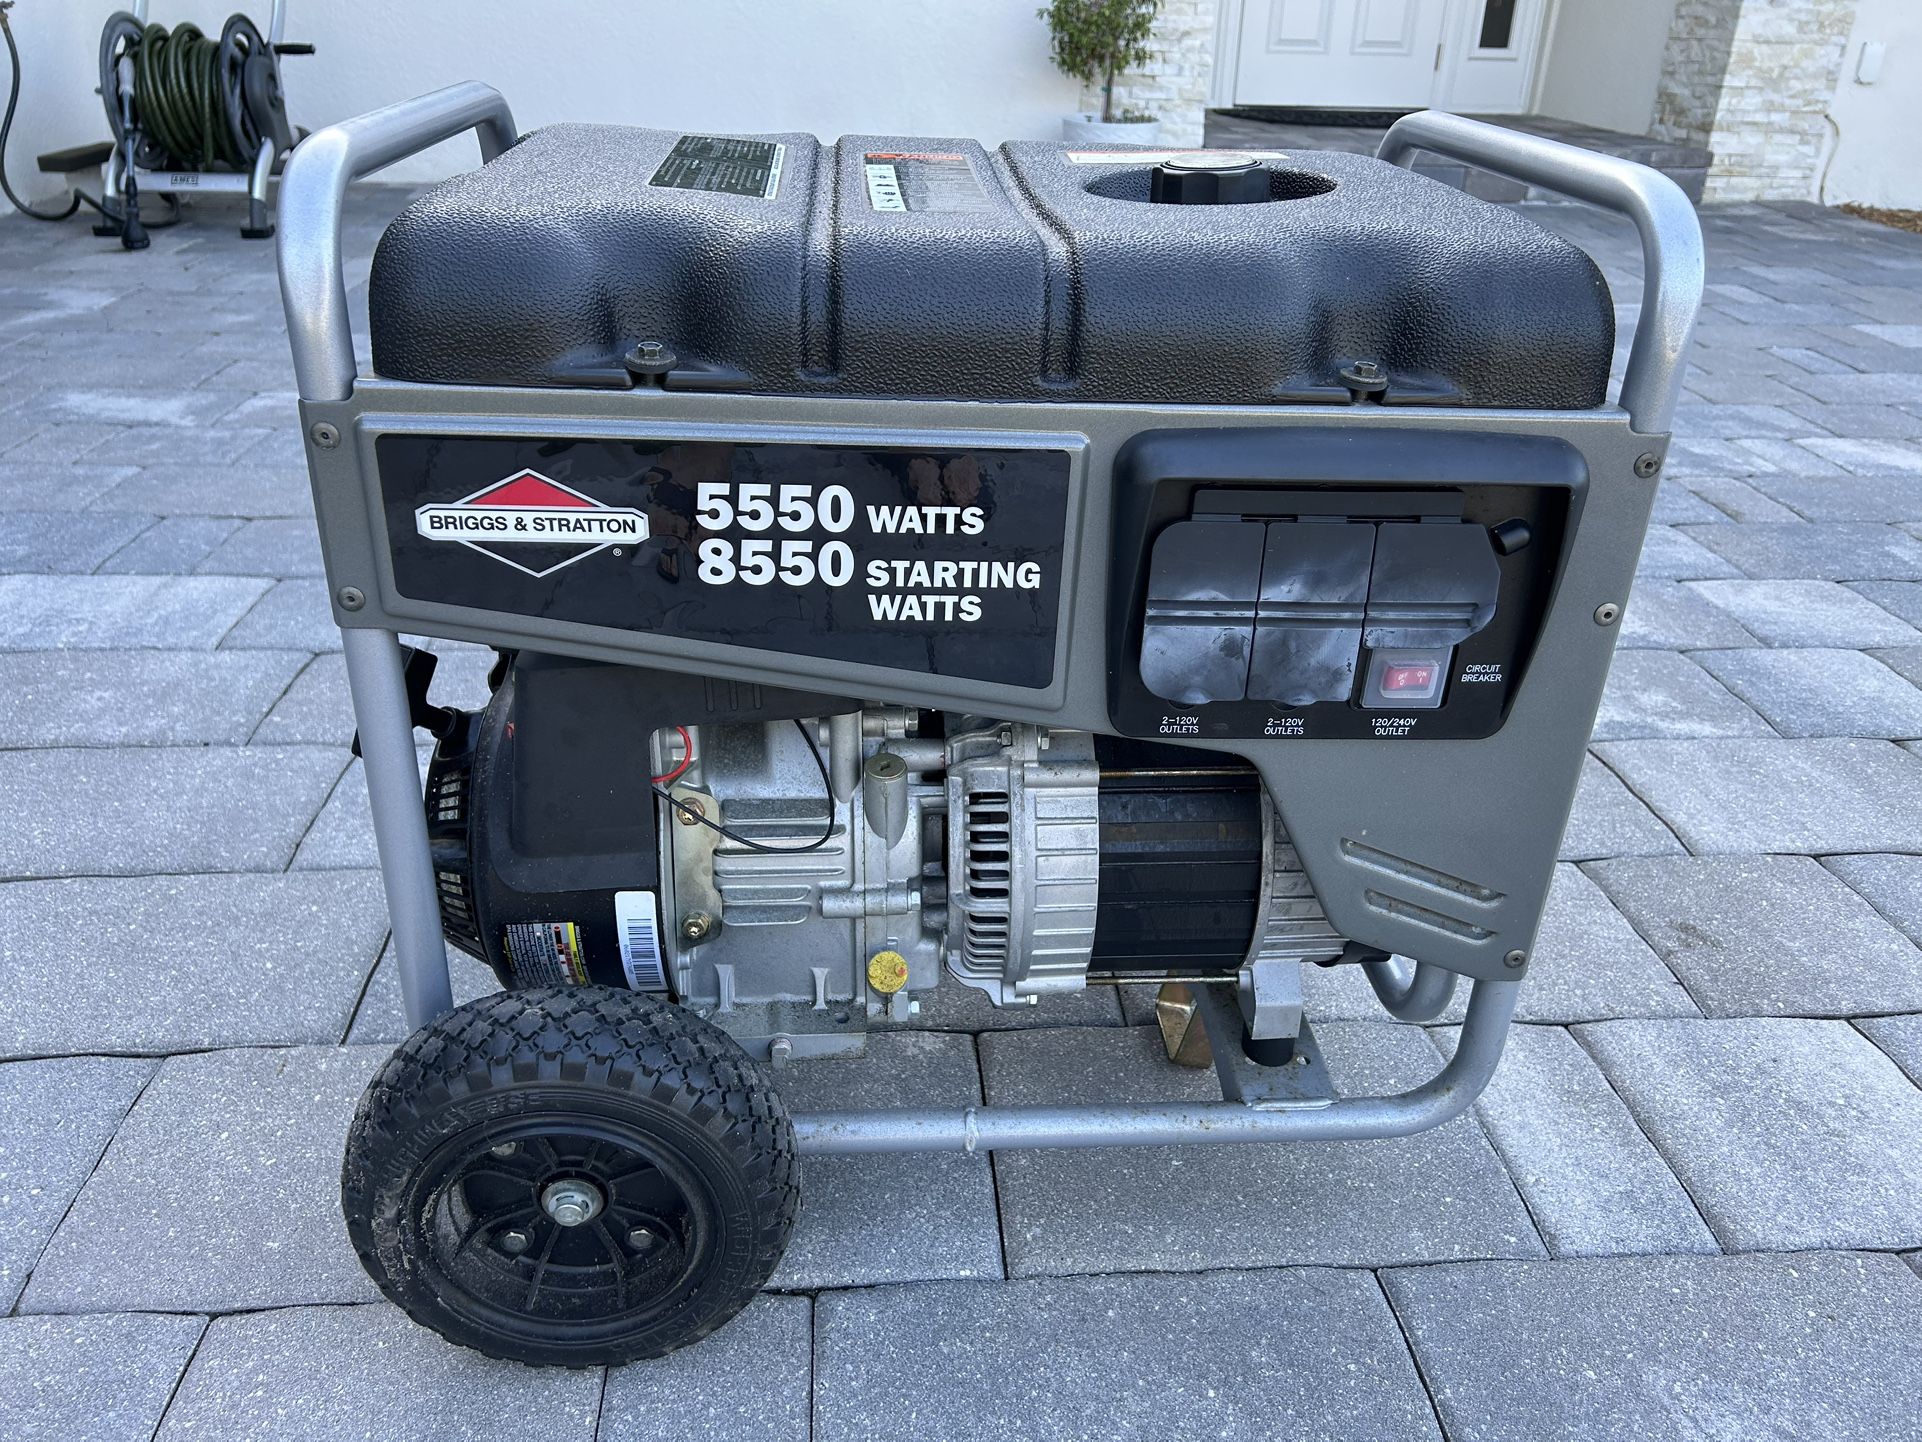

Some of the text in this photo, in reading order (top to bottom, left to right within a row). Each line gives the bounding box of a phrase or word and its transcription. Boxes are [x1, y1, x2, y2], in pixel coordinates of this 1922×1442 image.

[696, 483, 985, 535] 5550 WATTS
[429, 515, 637, 534] BRIGGS & STRATTON
[697, 539, 1041, 589] 8550 STARTING
[868, 595, 982, 622] WATTS
[1465, 664, 1501, 673] CIRCUIT
[1461, 673, 1503, 683] BREAKER
[1161, 715, 1199, 725] 2-120V
[1266, 717, 1305, 726] 2-120V
[1371, 717, 1418, 728] 120/240V
[1159, 725, 1199, 735] OUTLETS
[1264, 726, 1304, 735] OUTLETS
[1375, 727, 1411, 736] OUTLET
